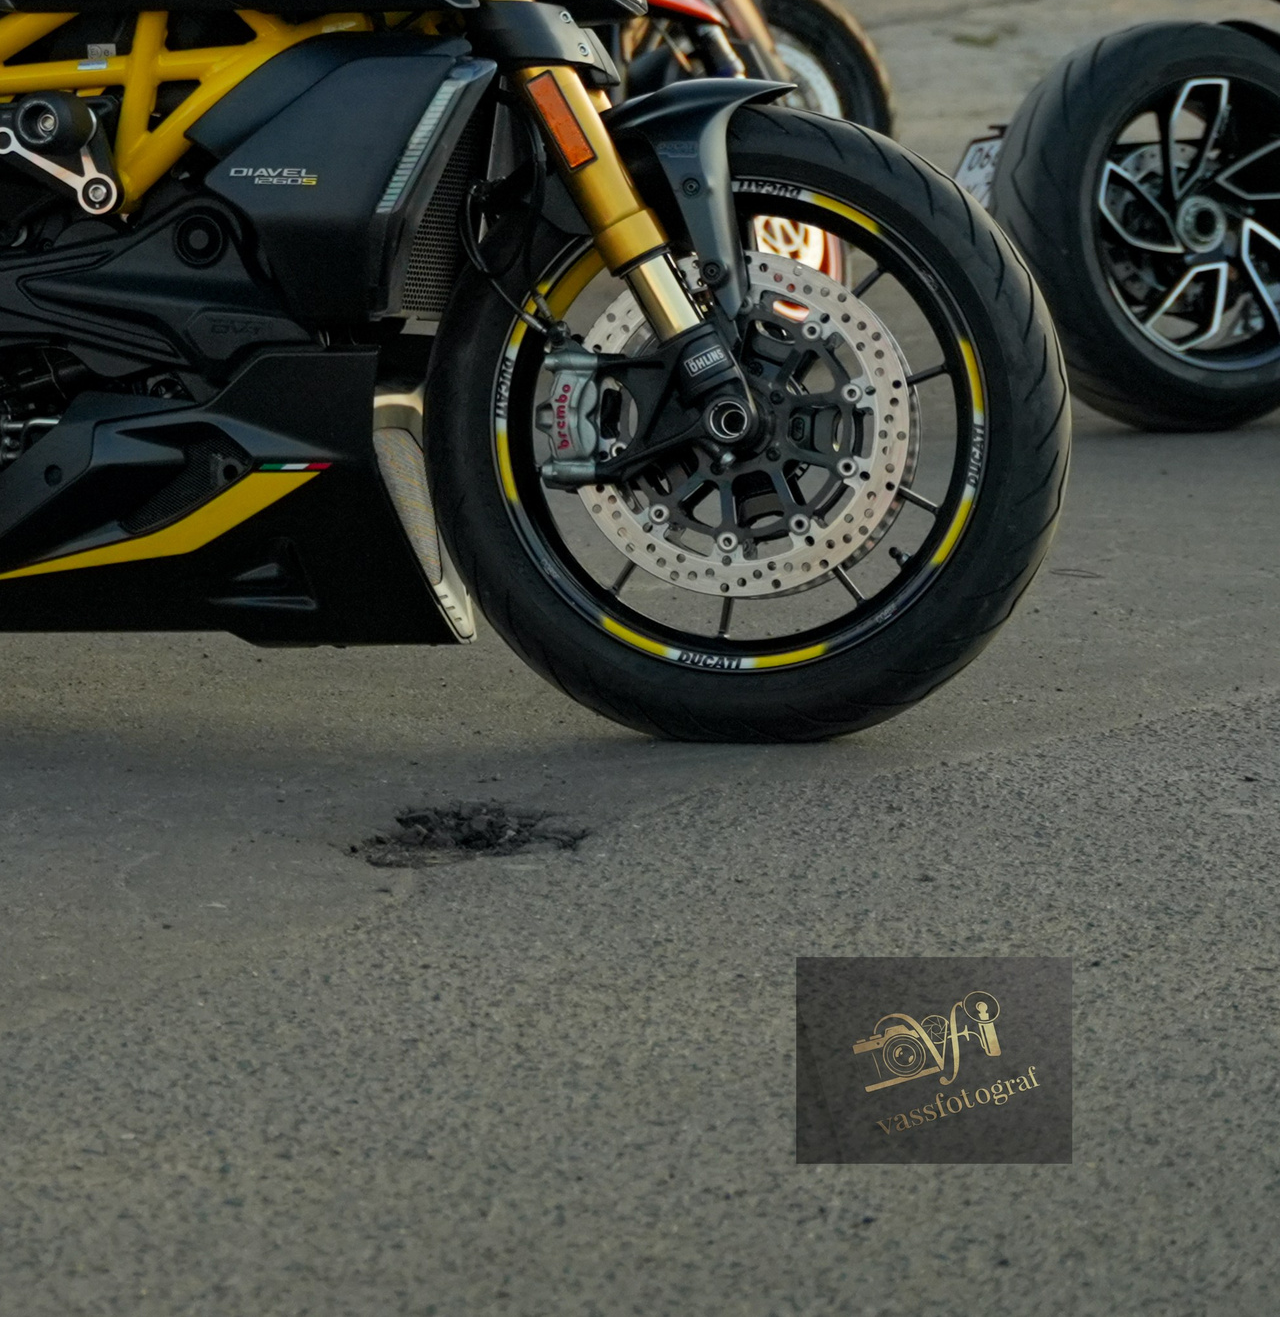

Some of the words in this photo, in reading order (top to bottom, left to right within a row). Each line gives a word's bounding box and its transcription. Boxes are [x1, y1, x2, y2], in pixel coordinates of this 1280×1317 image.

[229, 167, 318, 177] DIAVEL
[254, 177, 318, 185] 1260S
[690, 349, 725, 373] ÖHLINS
[496, 356, 516, 420] DUCATI
[554, 384, 571, 450] brembo
[966, 423, 984, 489] DUCATI
[678, 650, 742, 671] DUCATI
